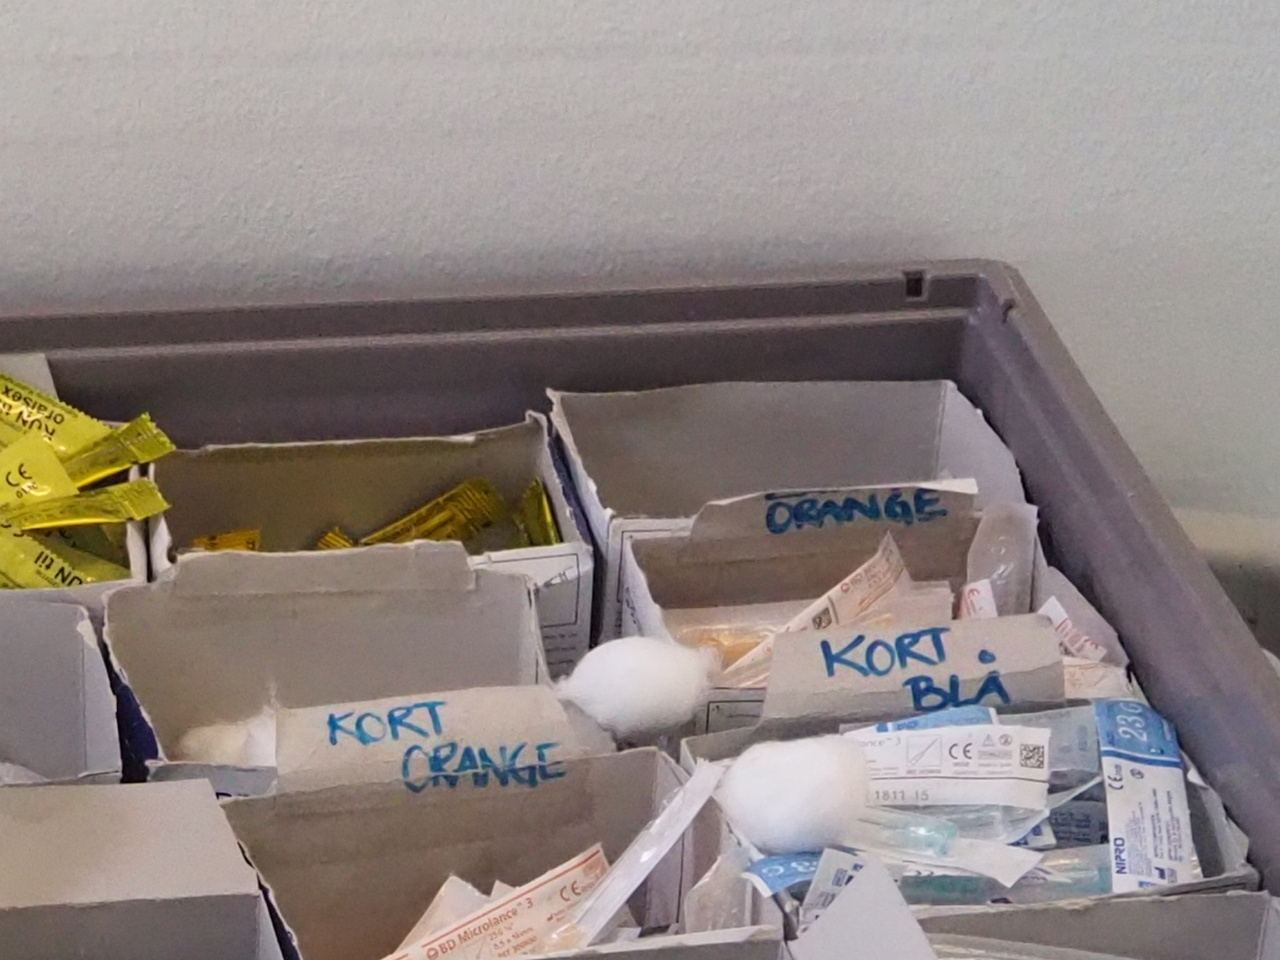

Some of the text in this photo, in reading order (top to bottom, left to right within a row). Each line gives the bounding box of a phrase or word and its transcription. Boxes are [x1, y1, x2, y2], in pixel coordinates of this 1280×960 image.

[0, 384, 66, 425] oralsex
[765, 488, 949, 535] ORANGE
[34, 550, 55, 571] til
[820, 626, 951, 679] KORT
[904, 649, 1013, 712] BLÅ
[327, 701, 449, 746] KORT
[402, 741, 568, 794] ORANGE
[1113, 836, 1128, 875] NIPRO
[438, 938, 457, 955] BD
[457, 906, 519, 944] Microlance
